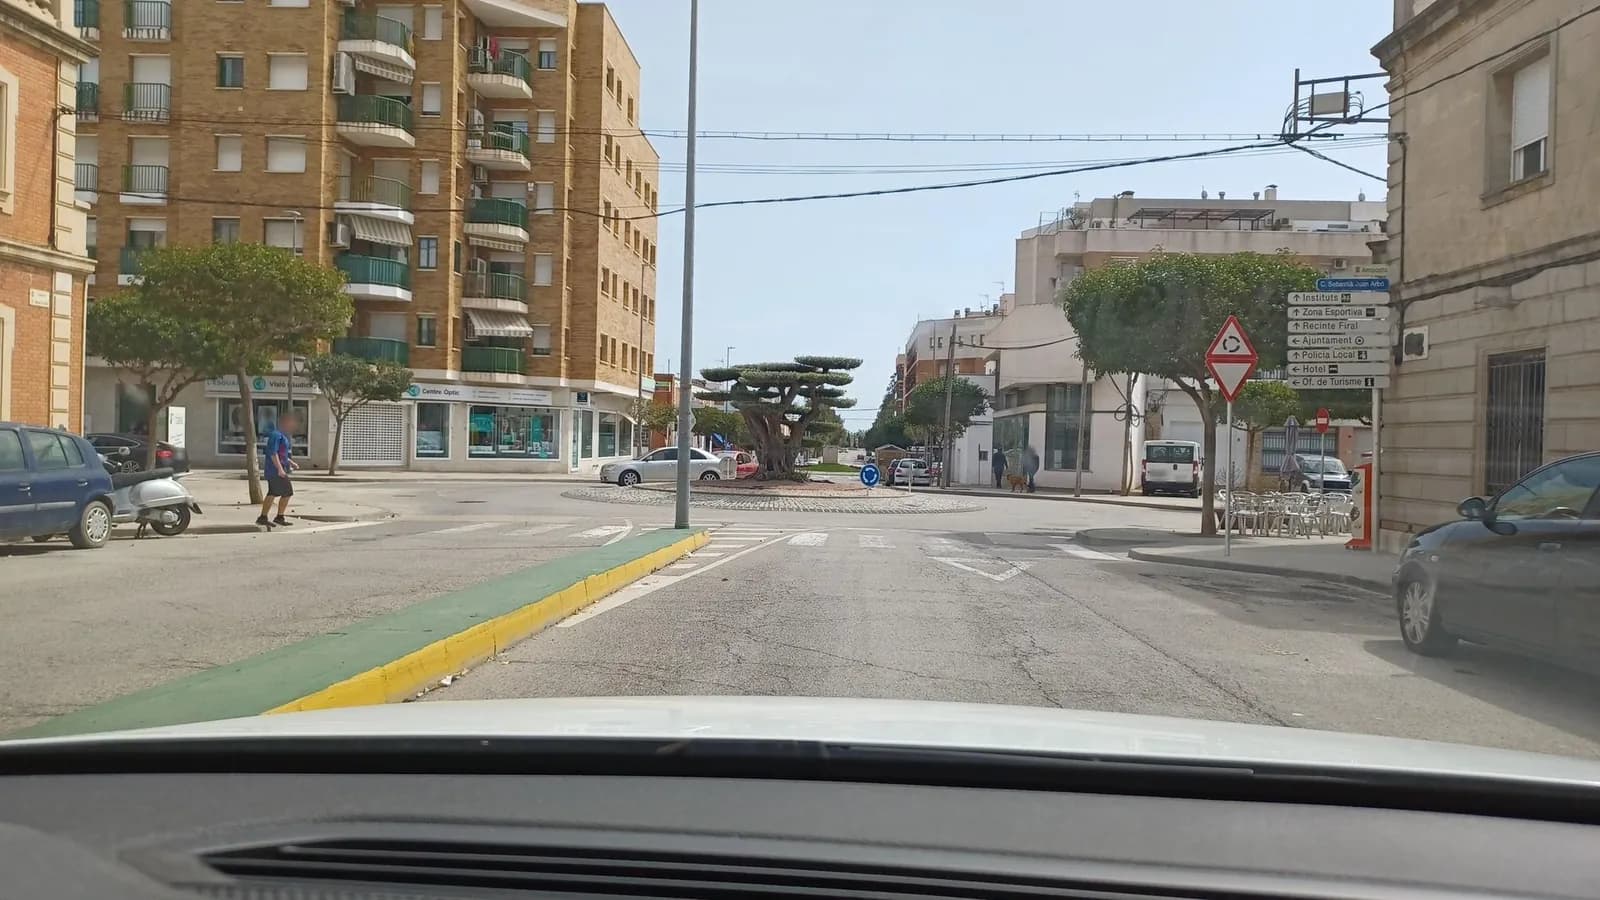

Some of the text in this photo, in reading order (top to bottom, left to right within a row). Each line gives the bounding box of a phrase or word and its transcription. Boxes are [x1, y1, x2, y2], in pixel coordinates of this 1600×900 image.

[1302, 293, 1339, 302] Instituts
[1302, 307, 1363, 318] Zona Esportiva
[1302, 321, 1359, 330] Recinte Firal
[1302, 336, 1352, 345] Ajuntament
[1332, 351, 1355, 359] Local
[1302, 365, 1326, 373] Hotel
[1302, 377, 1362, 386] Of. de Turisme
